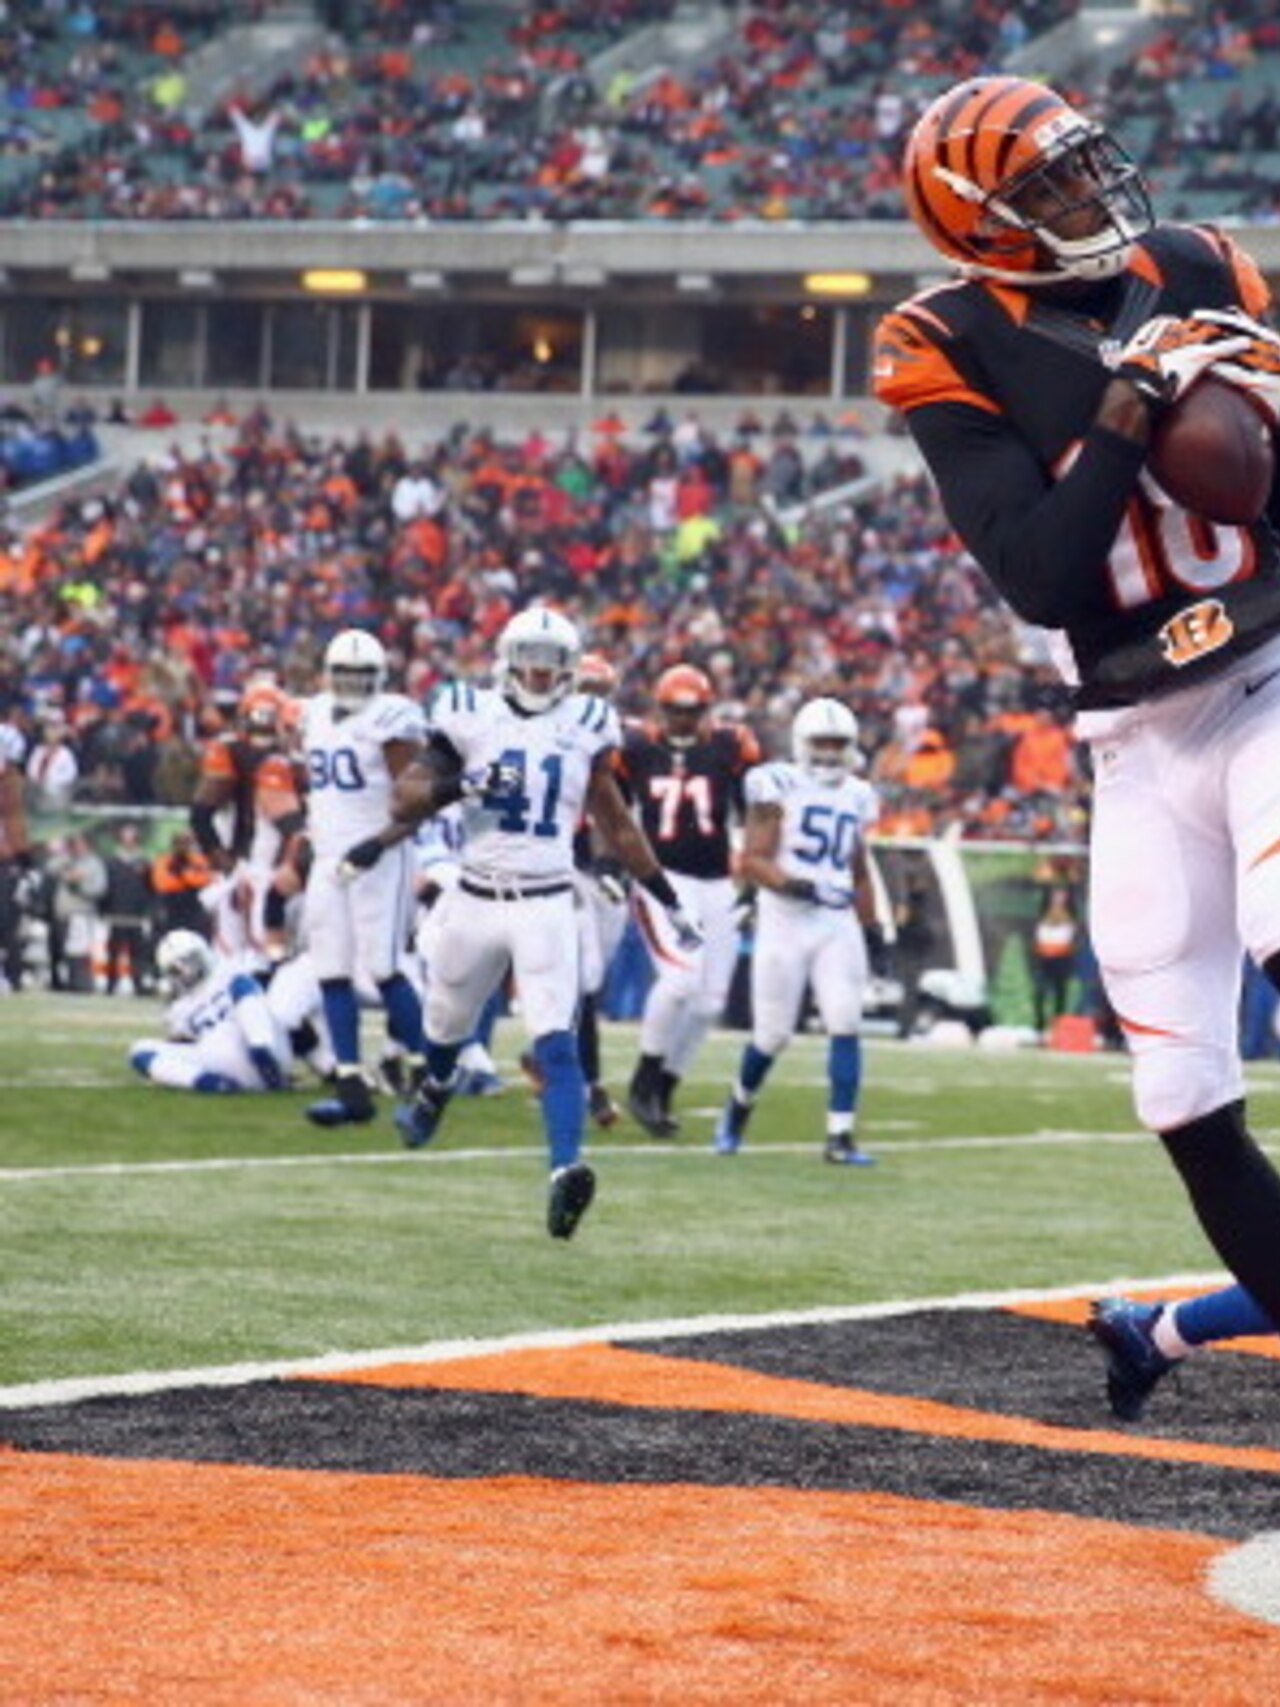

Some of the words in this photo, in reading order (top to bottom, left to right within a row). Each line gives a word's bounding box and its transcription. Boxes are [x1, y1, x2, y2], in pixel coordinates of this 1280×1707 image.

[484, 749, 562, 837] 41
[649, 775, 714, 841] 71
[793, 805, 858, 870] 50
